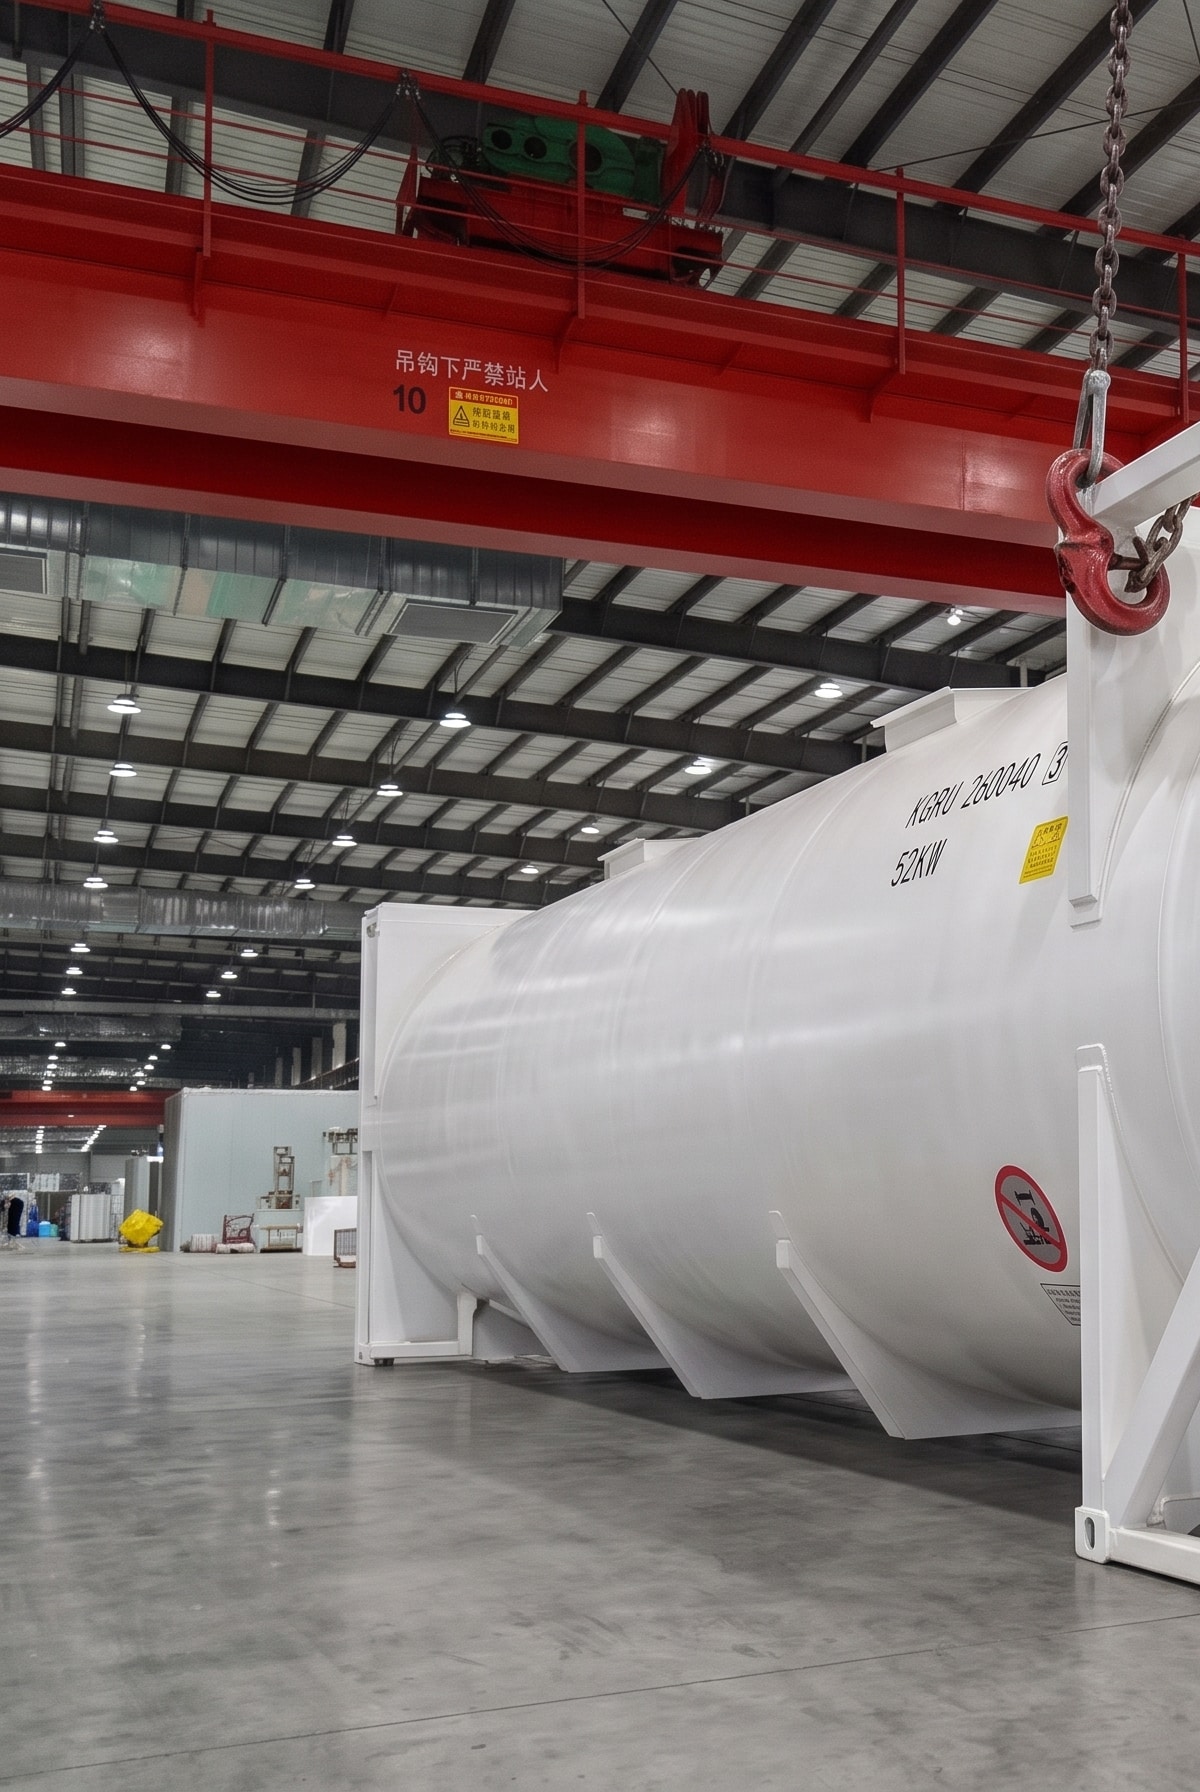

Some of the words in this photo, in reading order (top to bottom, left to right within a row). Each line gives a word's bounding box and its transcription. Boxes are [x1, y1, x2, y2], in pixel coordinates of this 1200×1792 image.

[395, 349, 549, 392] 吊钩下严禁站人
[393, 384, 426, 414] 10
[905, 781, 964, 829] KGRU
[960, 753, 1042, 809] 260040
[1048, 745, 1068, 779] 3
[891, 838, 948, 887] 52KW
